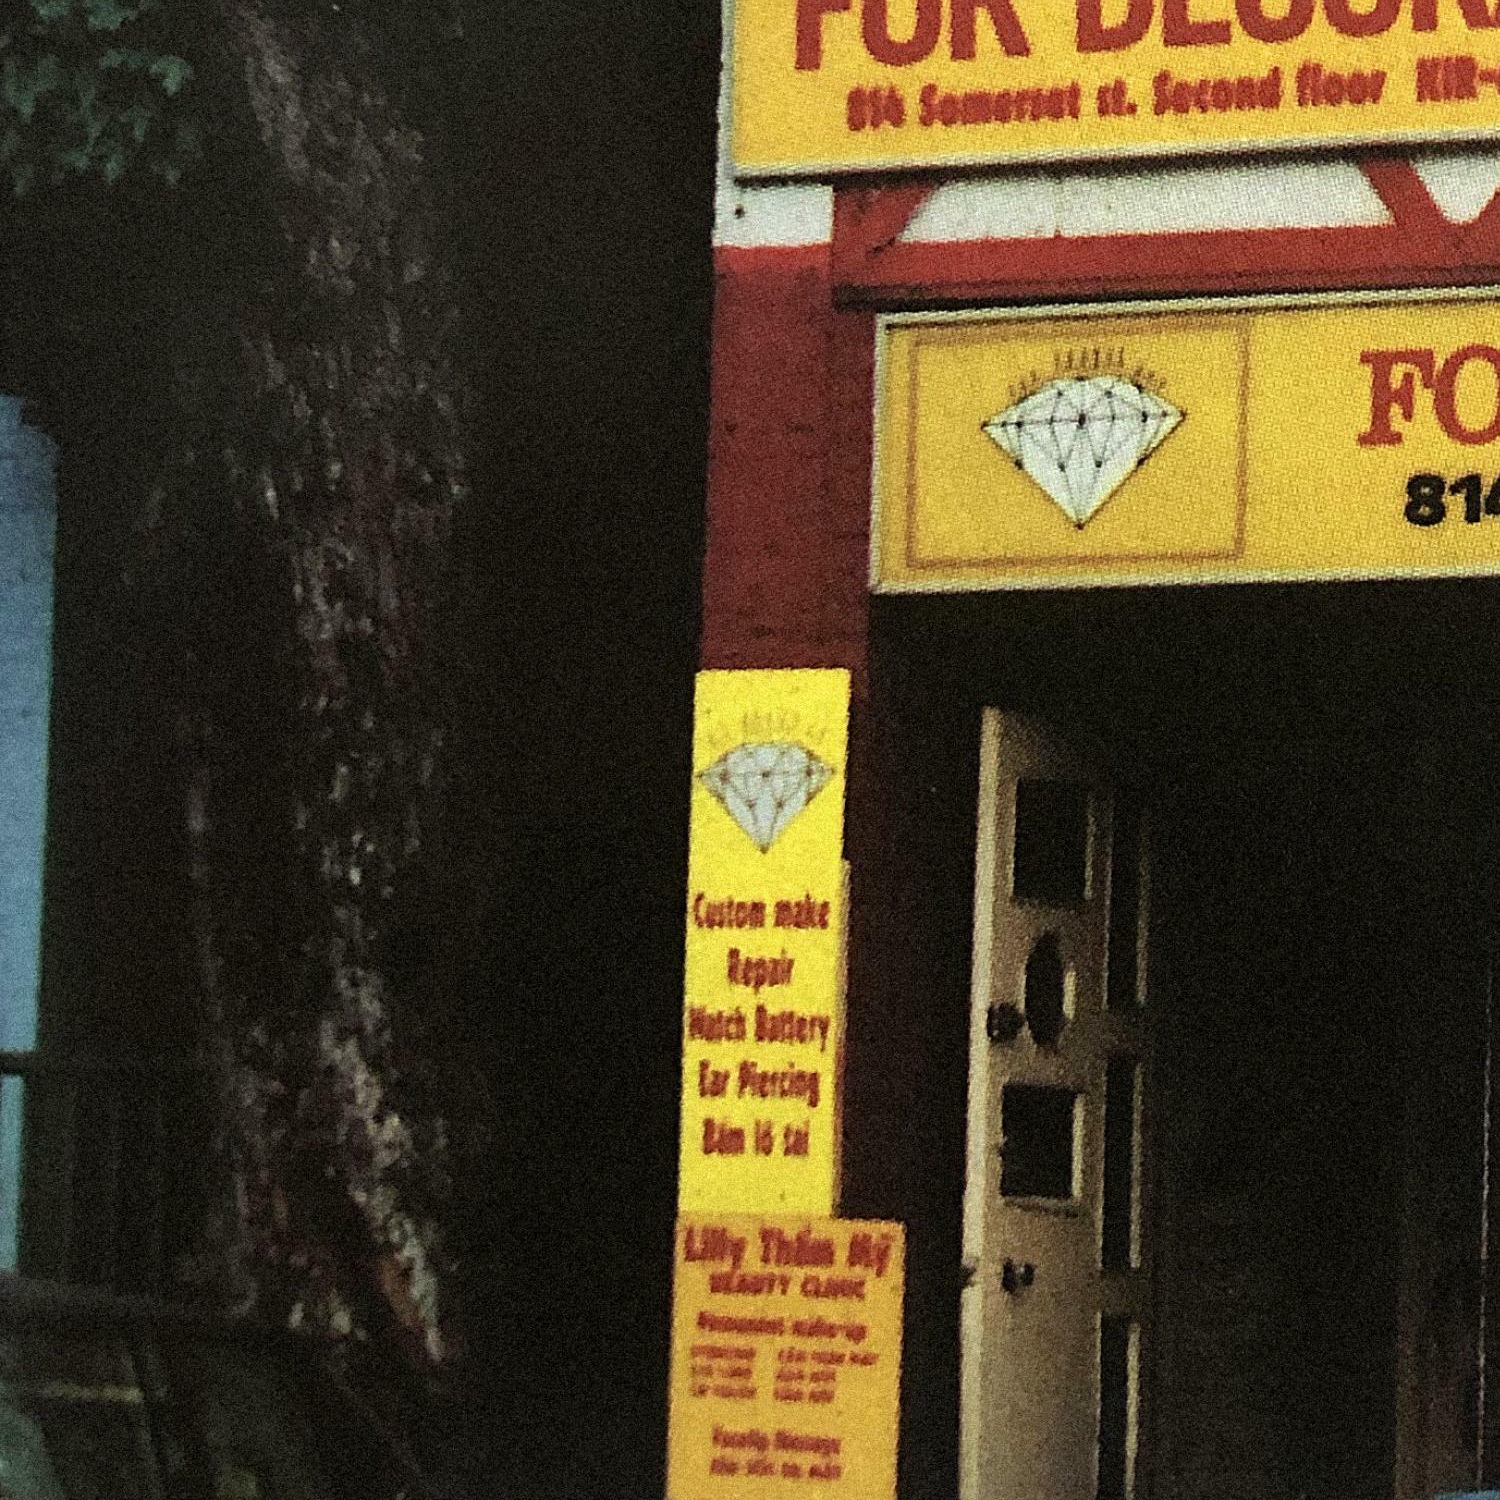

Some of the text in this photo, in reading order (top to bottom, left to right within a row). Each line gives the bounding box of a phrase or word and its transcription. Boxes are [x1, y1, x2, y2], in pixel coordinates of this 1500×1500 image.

[1152, 68, 1283, 117] Second
[693, 892, 766, 929] Custom
[727, 947, 795, 995] Repair
[754, 1003, 830, 1052] Battery
[737, 1060, 820, 1108] Piercing
